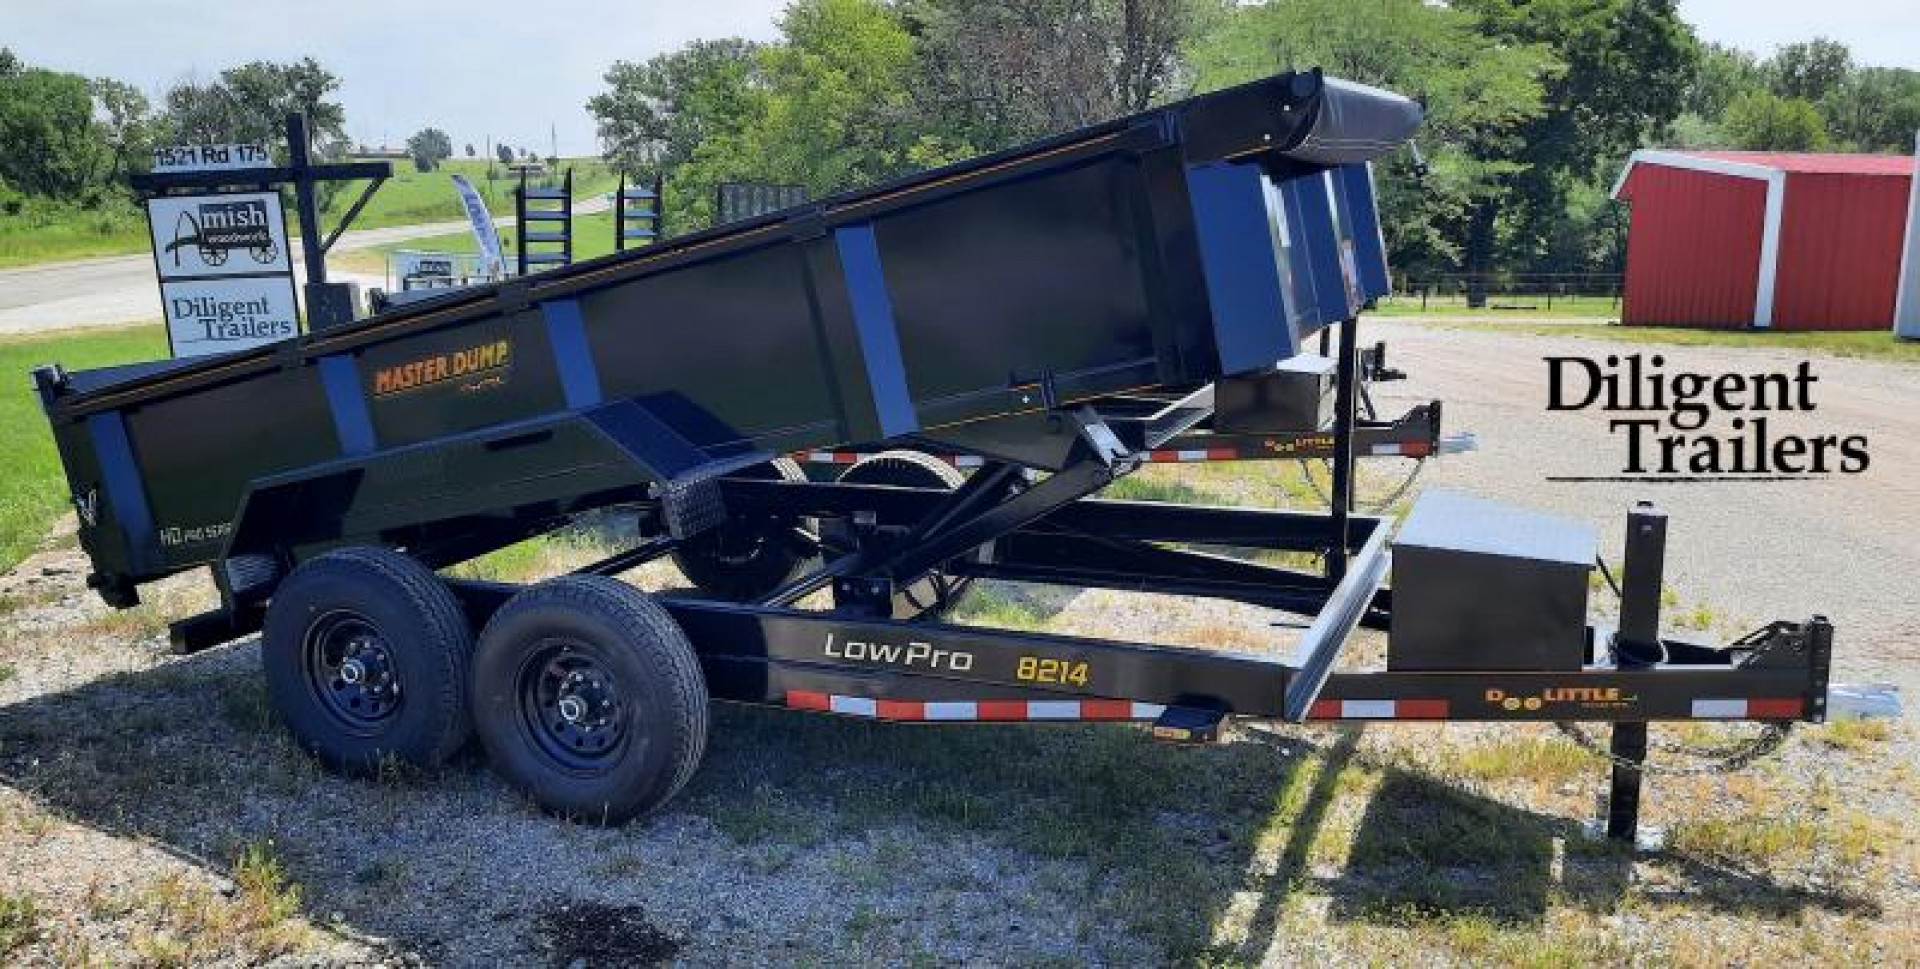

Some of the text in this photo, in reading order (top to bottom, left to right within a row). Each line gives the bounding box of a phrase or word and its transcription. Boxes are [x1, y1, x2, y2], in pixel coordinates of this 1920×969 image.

[202, 147, 229, 164] Rd
[236, 145, 267, 162] 175
[166, 202, 267, 266] Amish
[173, 297, 269, 322] Diligent
[199, 317, 291, 339] Trailers
[375, 356, 448, 394] MASTER
[453, 341, 508, 376] DUMP
[1016, 656, 1089, 686] 8214
